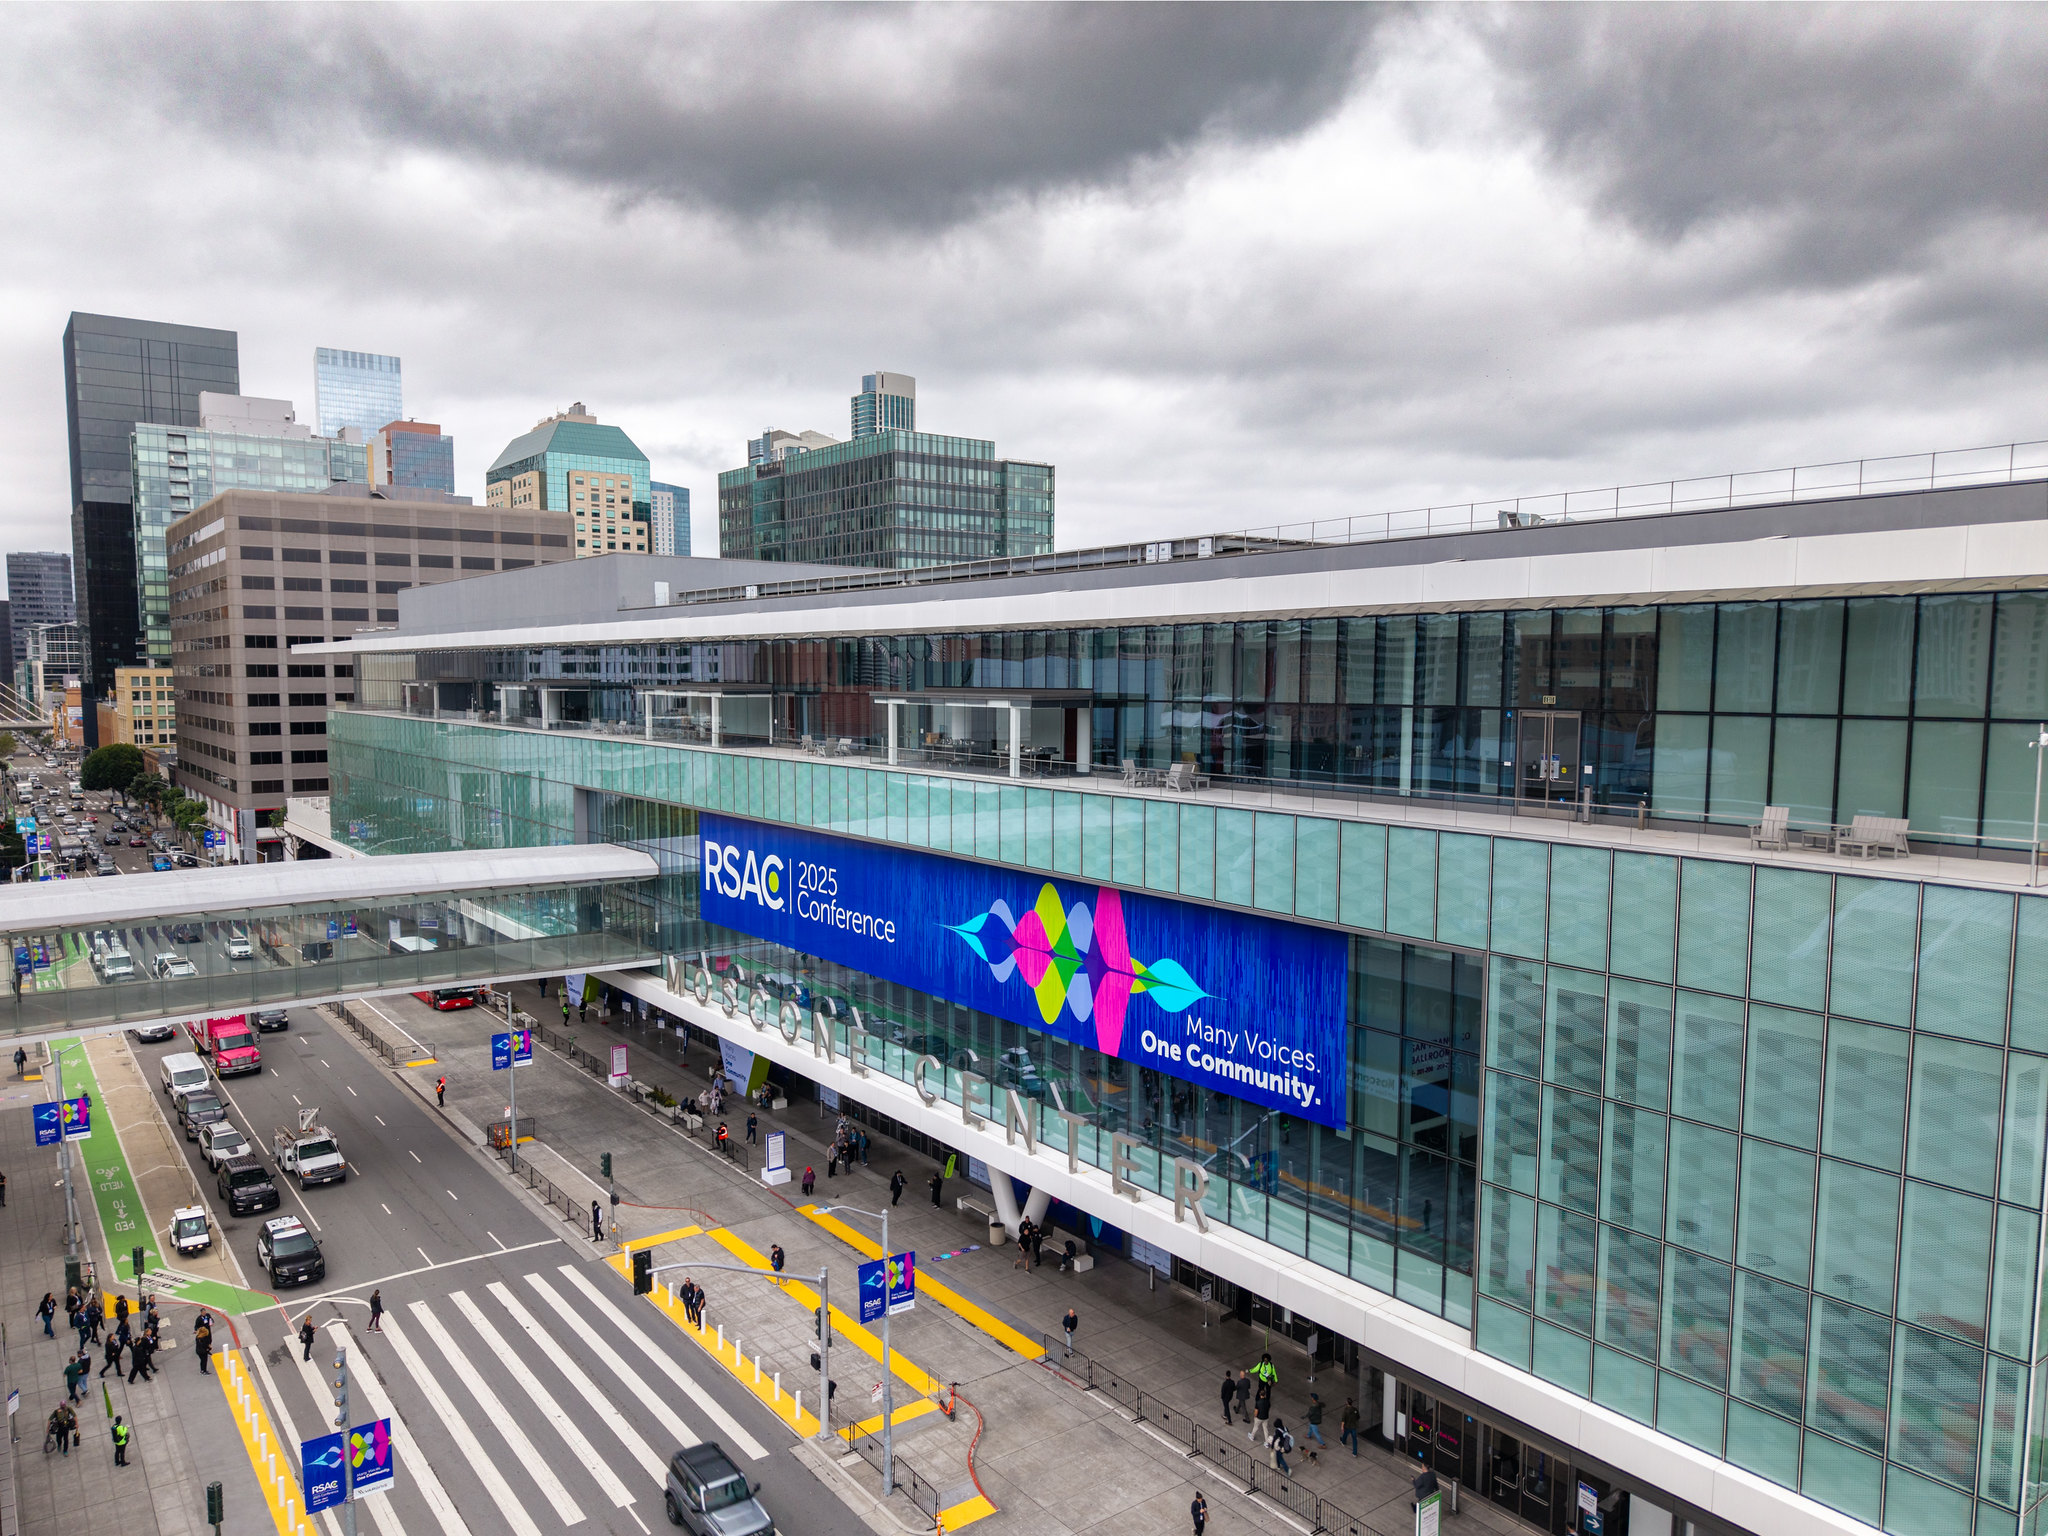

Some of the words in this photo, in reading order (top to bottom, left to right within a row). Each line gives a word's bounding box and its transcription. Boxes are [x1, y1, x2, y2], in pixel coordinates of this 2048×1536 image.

[704, 840, 785, 910] RSAC
[797, 861, 838, 896] 2025
[797, 891, 896, 943] Conference
[1186, 1014, 1239, 1055] Many
[1244, 1030, 1321, 1073] Voices.
[1141, 1029, 1182, 1062] One
[1186, 1044, 1322, 1107] Community.
[667, 955, 870, 1079] MOSCONE
[914, 1054, 1209, 1234] CENTER
[100, 1180, 125, 1191] YIELD
[112, 1199, 126, 1209] TO
[114, 1219, 135, 1231] PED
[865, 1298, 882, 1309] RSAC
[312, 1480, 338, 1494] RSAC
